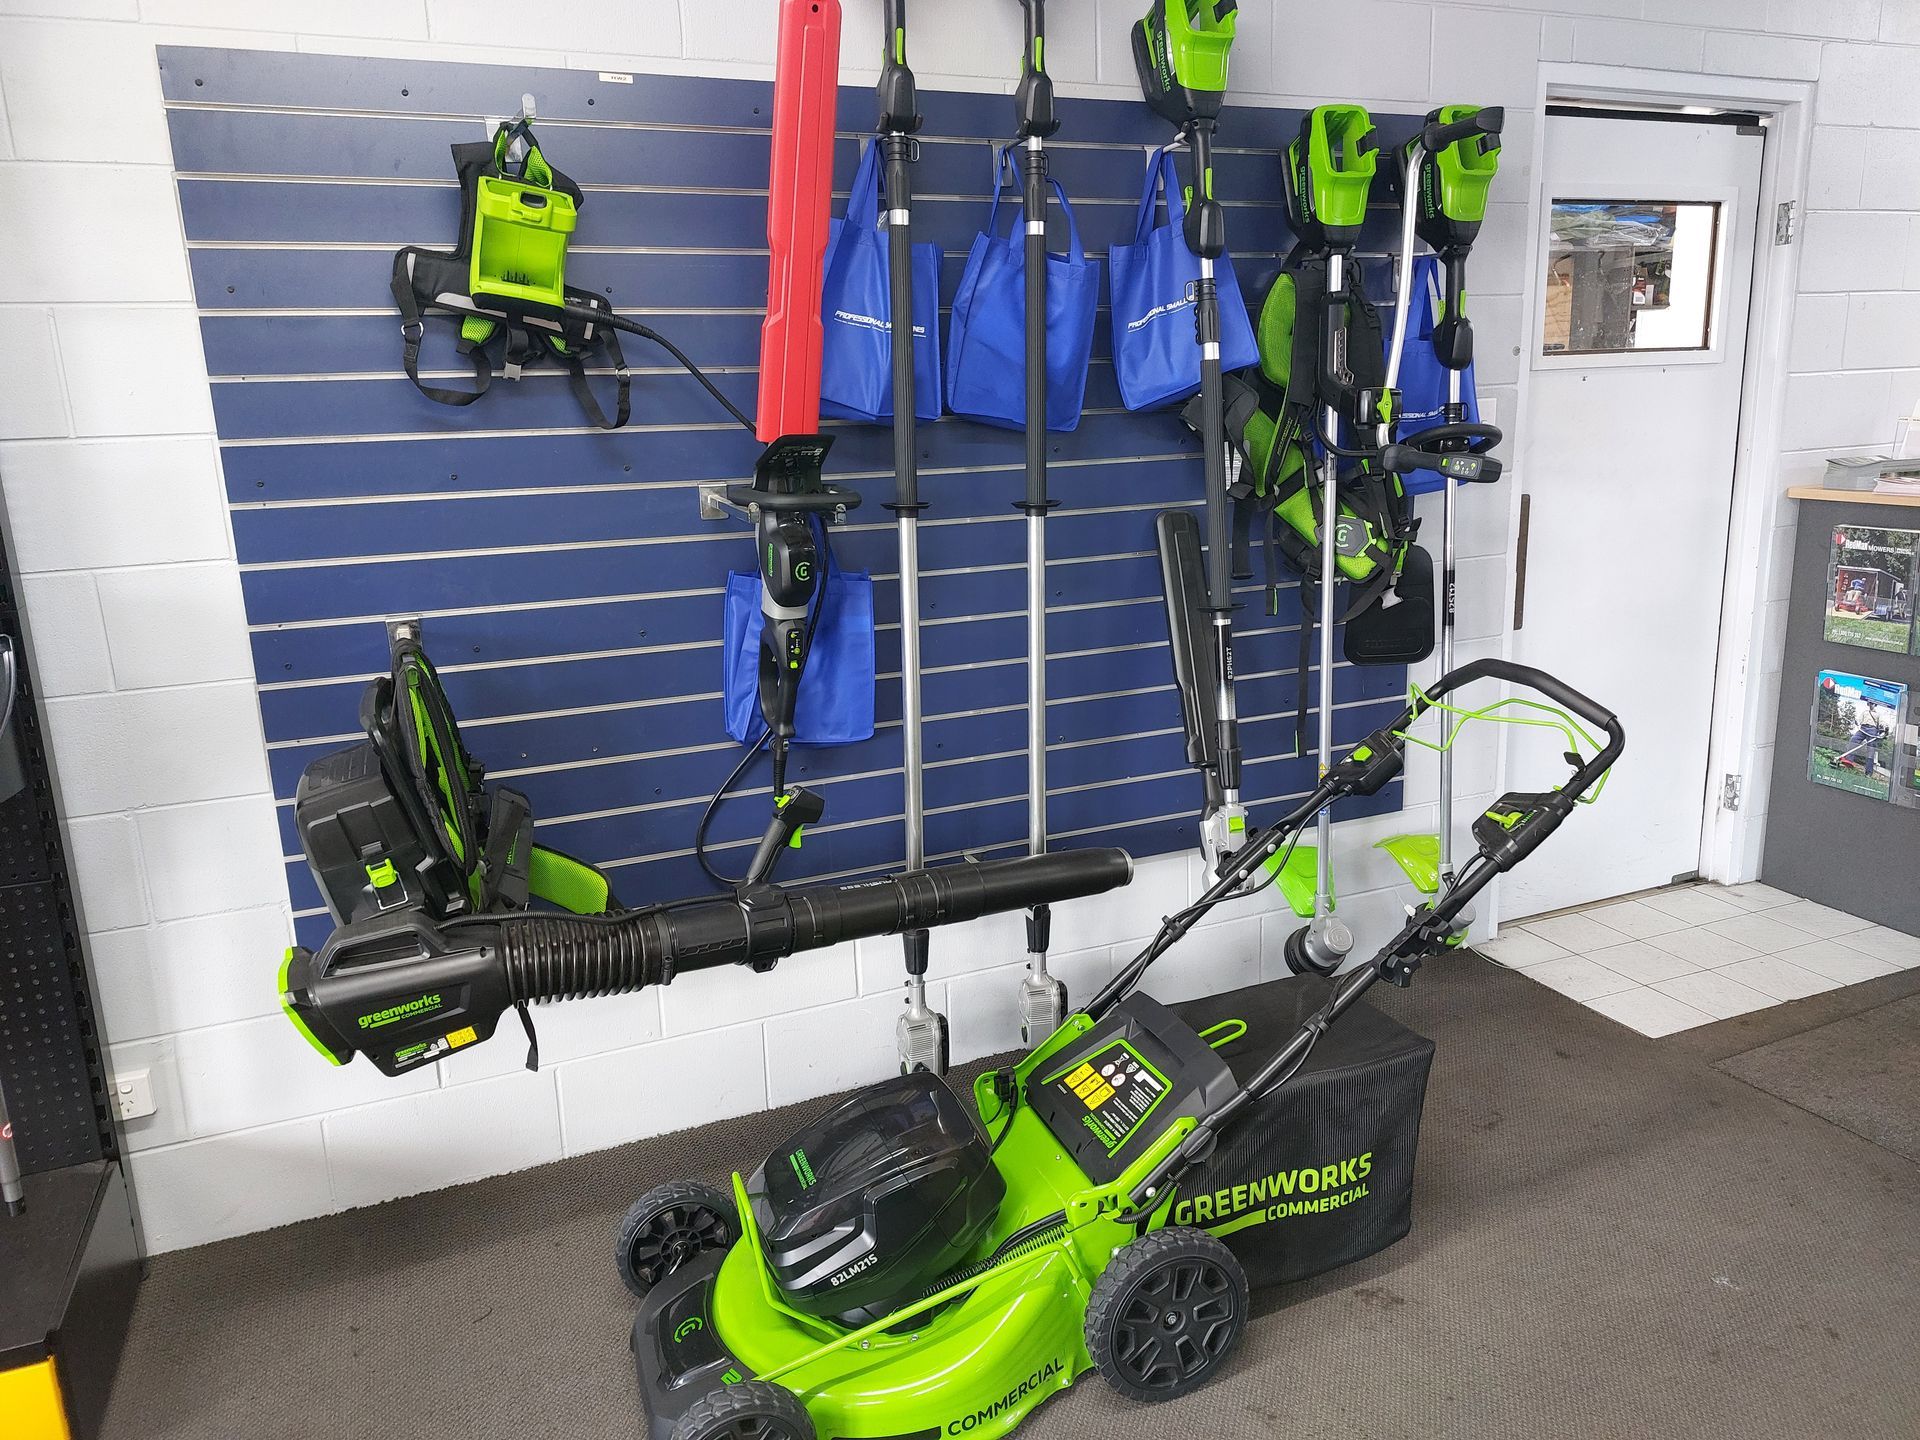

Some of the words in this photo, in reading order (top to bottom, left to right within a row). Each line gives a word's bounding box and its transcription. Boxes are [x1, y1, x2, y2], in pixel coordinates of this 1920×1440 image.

[1157, 31, 1171, 91] greenworks
[1301, 166, 1310, 223] greenworks
[1424, 163, 1435, 219] greenworks
[834, 310, 885, 327] PROFESSIONAL
[1166, 298, 1187, 310] SMALL
[1845, 539, 1869, 551] RedMax
[1869, 545, 1894, 554] MOWERS
[358, 994, 441, 1029] greenworks
[401, 1004, 443, 1019] COMMERCIAL
[1082, 1115, 1118, 1149] greenworks
[795, 1149, 817, 1186] GREENWORKS
[1175, 1151, 1373, 1226] GREENWORKS
[1267, 1182, 1370, 1221] COMMERCIAL
[830, 1253, 878, 1286] 82LM21S
[947, 1358, 1064, 1436] COMMERCIAL
